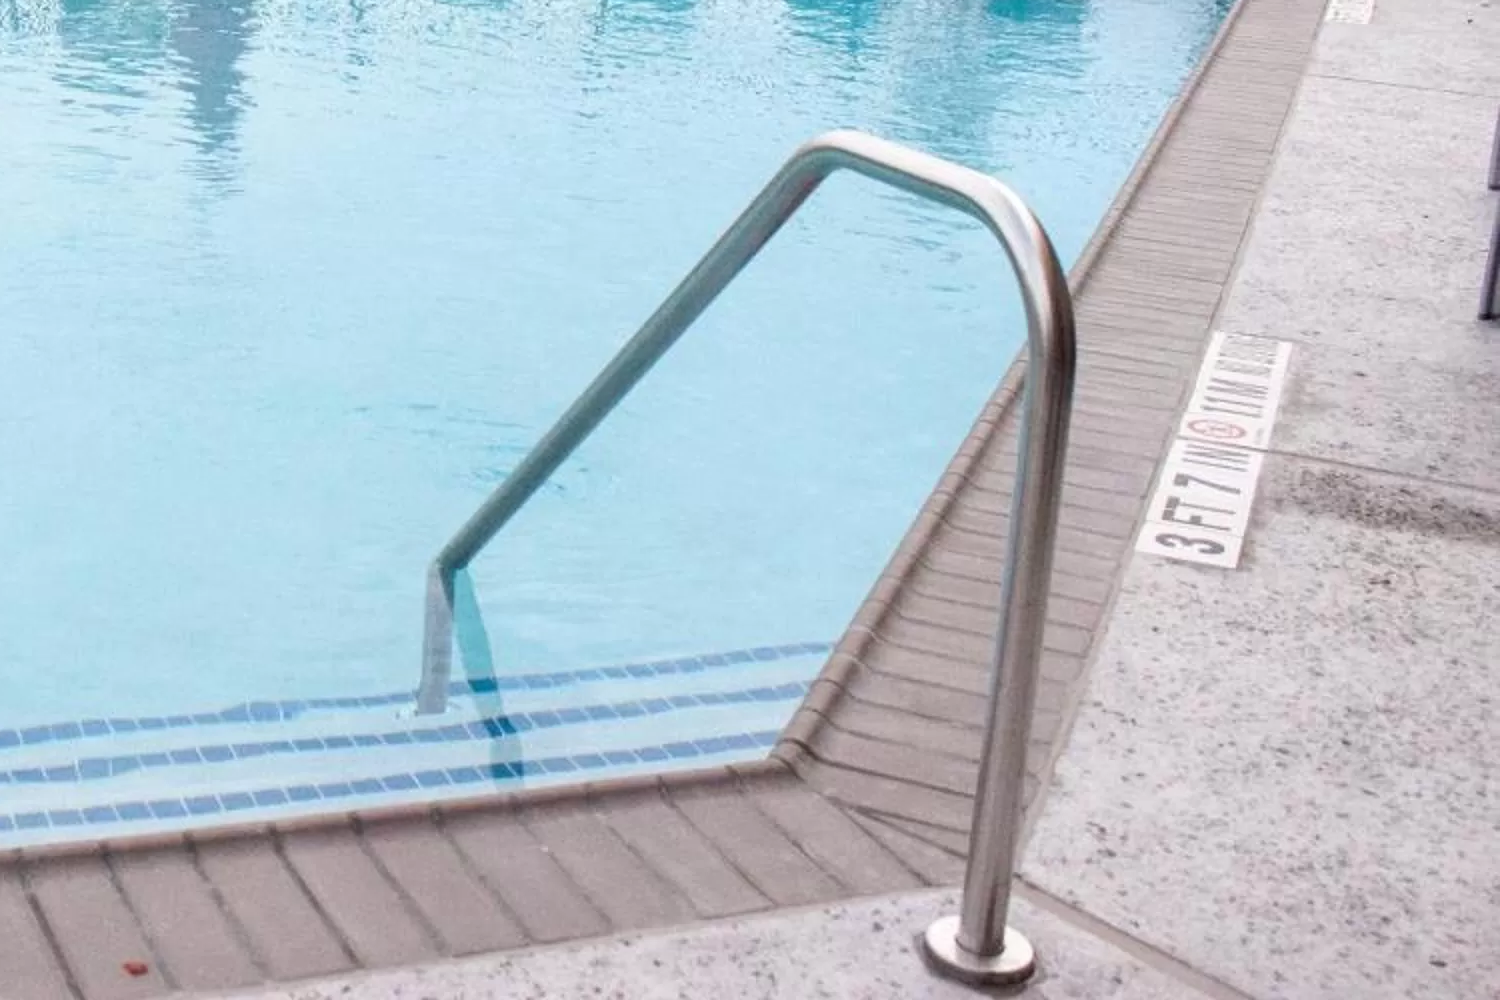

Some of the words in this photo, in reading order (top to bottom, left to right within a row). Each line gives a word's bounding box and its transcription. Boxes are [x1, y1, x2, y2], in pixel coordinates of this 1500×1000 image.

[1181, 442, 1251, 472] IN
[1173, 472, 1242, 494] 7
[1161, 495, 1237, 531] FT
[1155, 533, 1225, 554] 3
